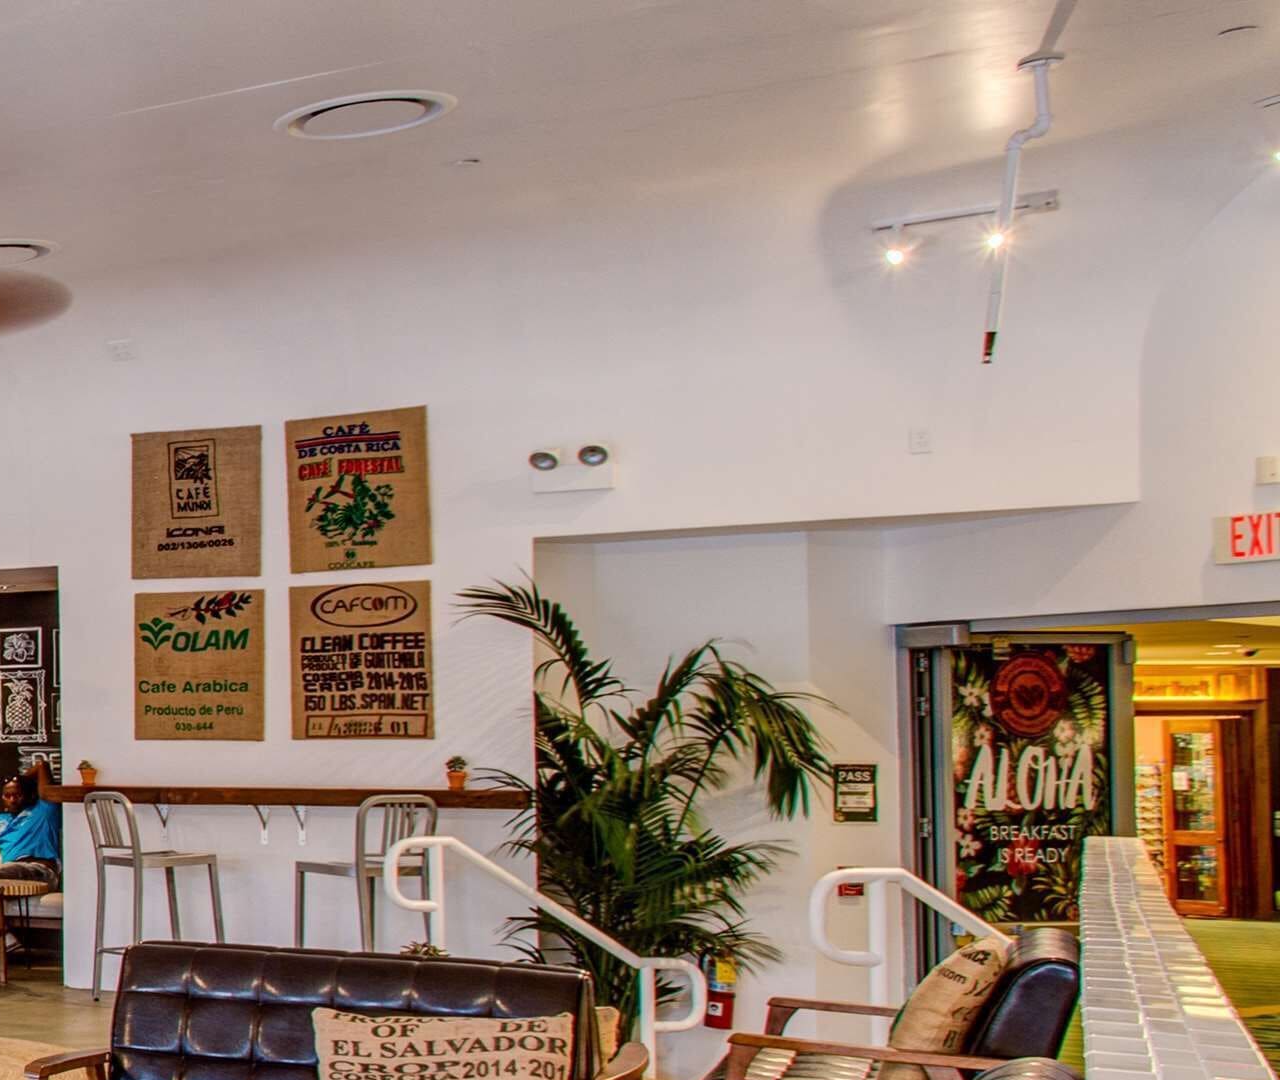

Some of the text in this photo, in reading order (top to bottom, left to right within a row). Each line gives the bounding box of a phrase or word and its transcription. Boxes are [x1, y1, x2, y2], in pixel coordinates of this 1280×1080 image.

[323, 421, 371, 437] CAFÉ
[298, 440, 401, 459] DE COSTA RICA
[176, 483, 211, 500] CAFÉ
[172, 628, 250, 652] OLAM
[301, 632, 425, 653] CLEAN COFFEE
[139, 679, 249, 693] Cafe Arabica
[302, 681, 364, 692] CROP
[366, 672, 428, 690] 2014-2015
[144, 705, 196, 716] Producto
[199, 705, 213, 715] de
[304, 695, 326, 711] 150
[838, 771, 871, 782] PASS
[963, 743, 1096, 810] ALOHA
[990, 825, 1077, 841] BREAKFAST
[998, 847, 1070, 863] IS READY
[371, 1019, 548, 1038] OF DE
[330, 1035, 568, 1059] EL SALVADOR
[328, 1061, 463, 1074] CROP
